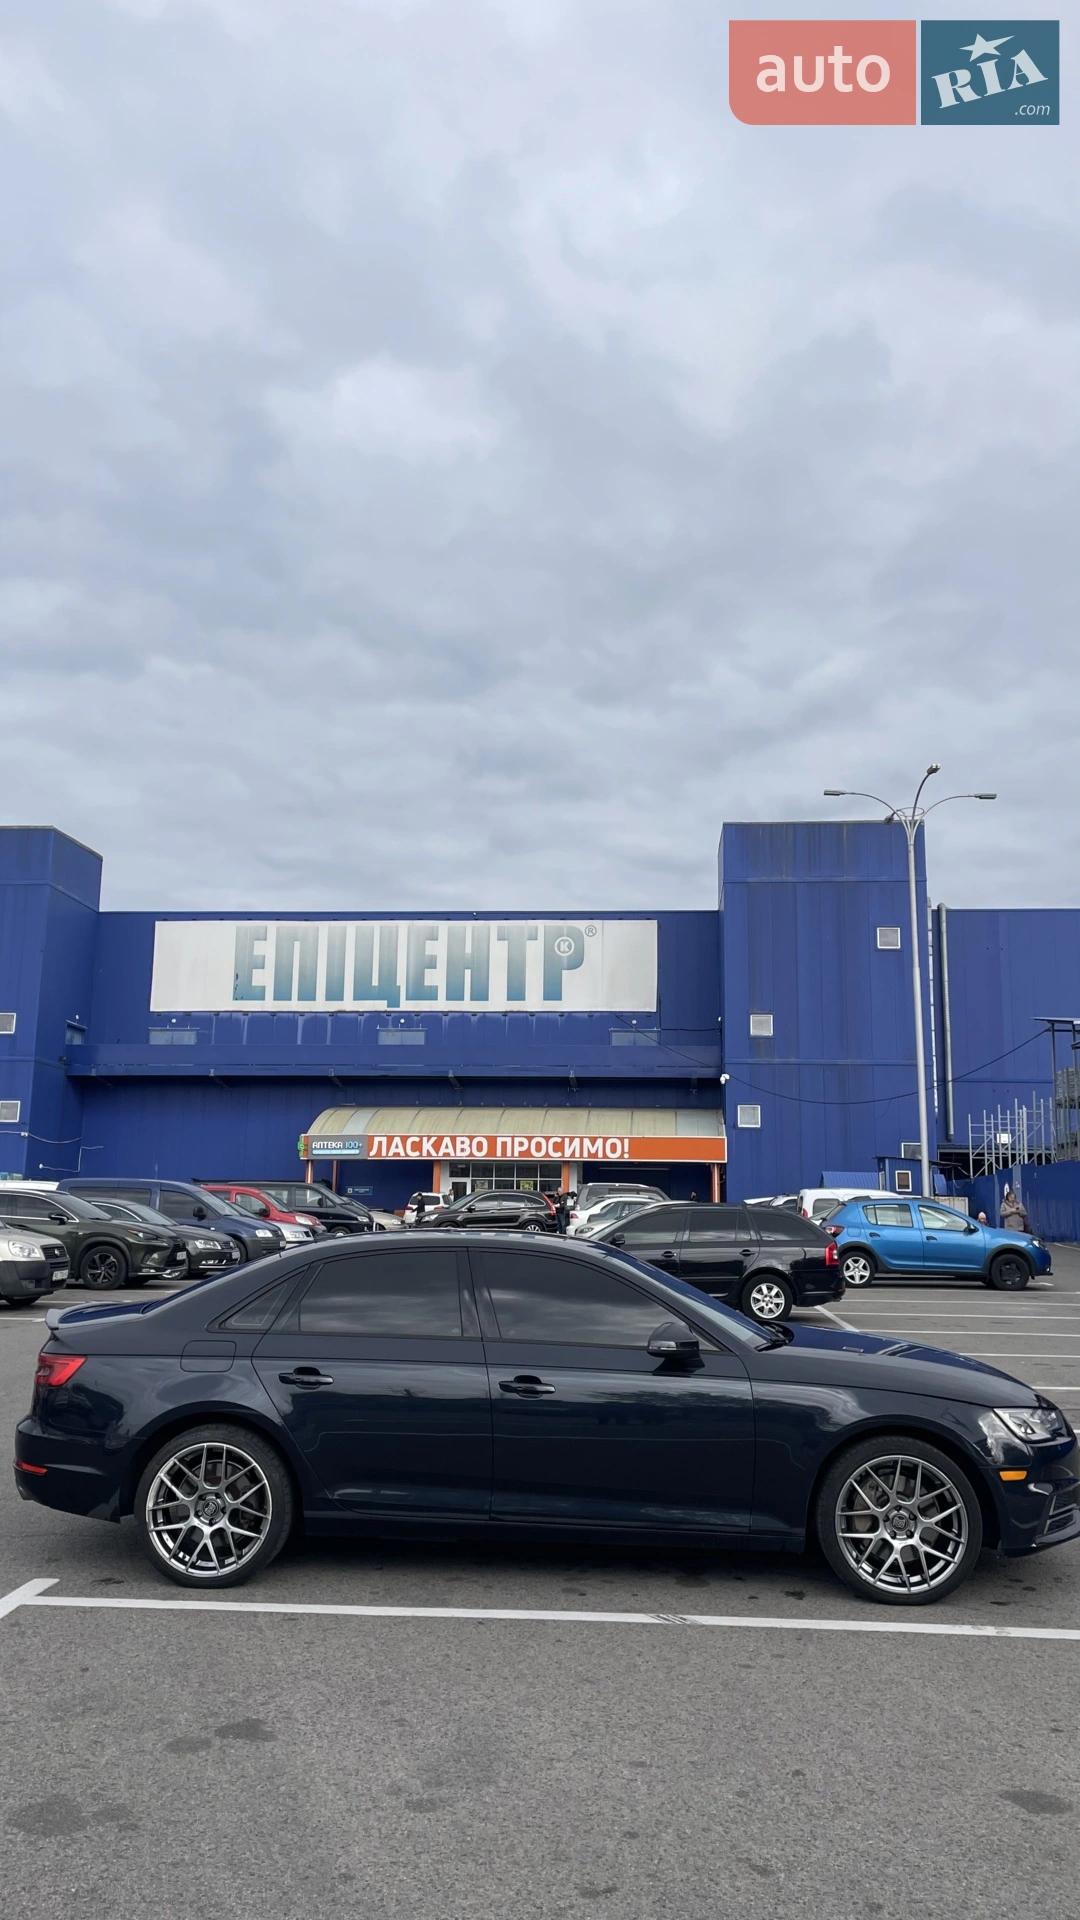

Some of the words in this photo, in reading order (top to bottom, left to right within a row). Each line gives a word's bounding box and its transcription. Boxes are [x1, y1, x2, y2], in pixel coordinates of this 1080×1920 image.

[232, 924, 585, 1008] ЕПІЦЕНТР
[312, 1141, 342, 1149] АПТЕКА
[369, 1136, 488, 1158] ЛАСКАВО
[496, 1136, 630, 1159] ПРОСИМО!
